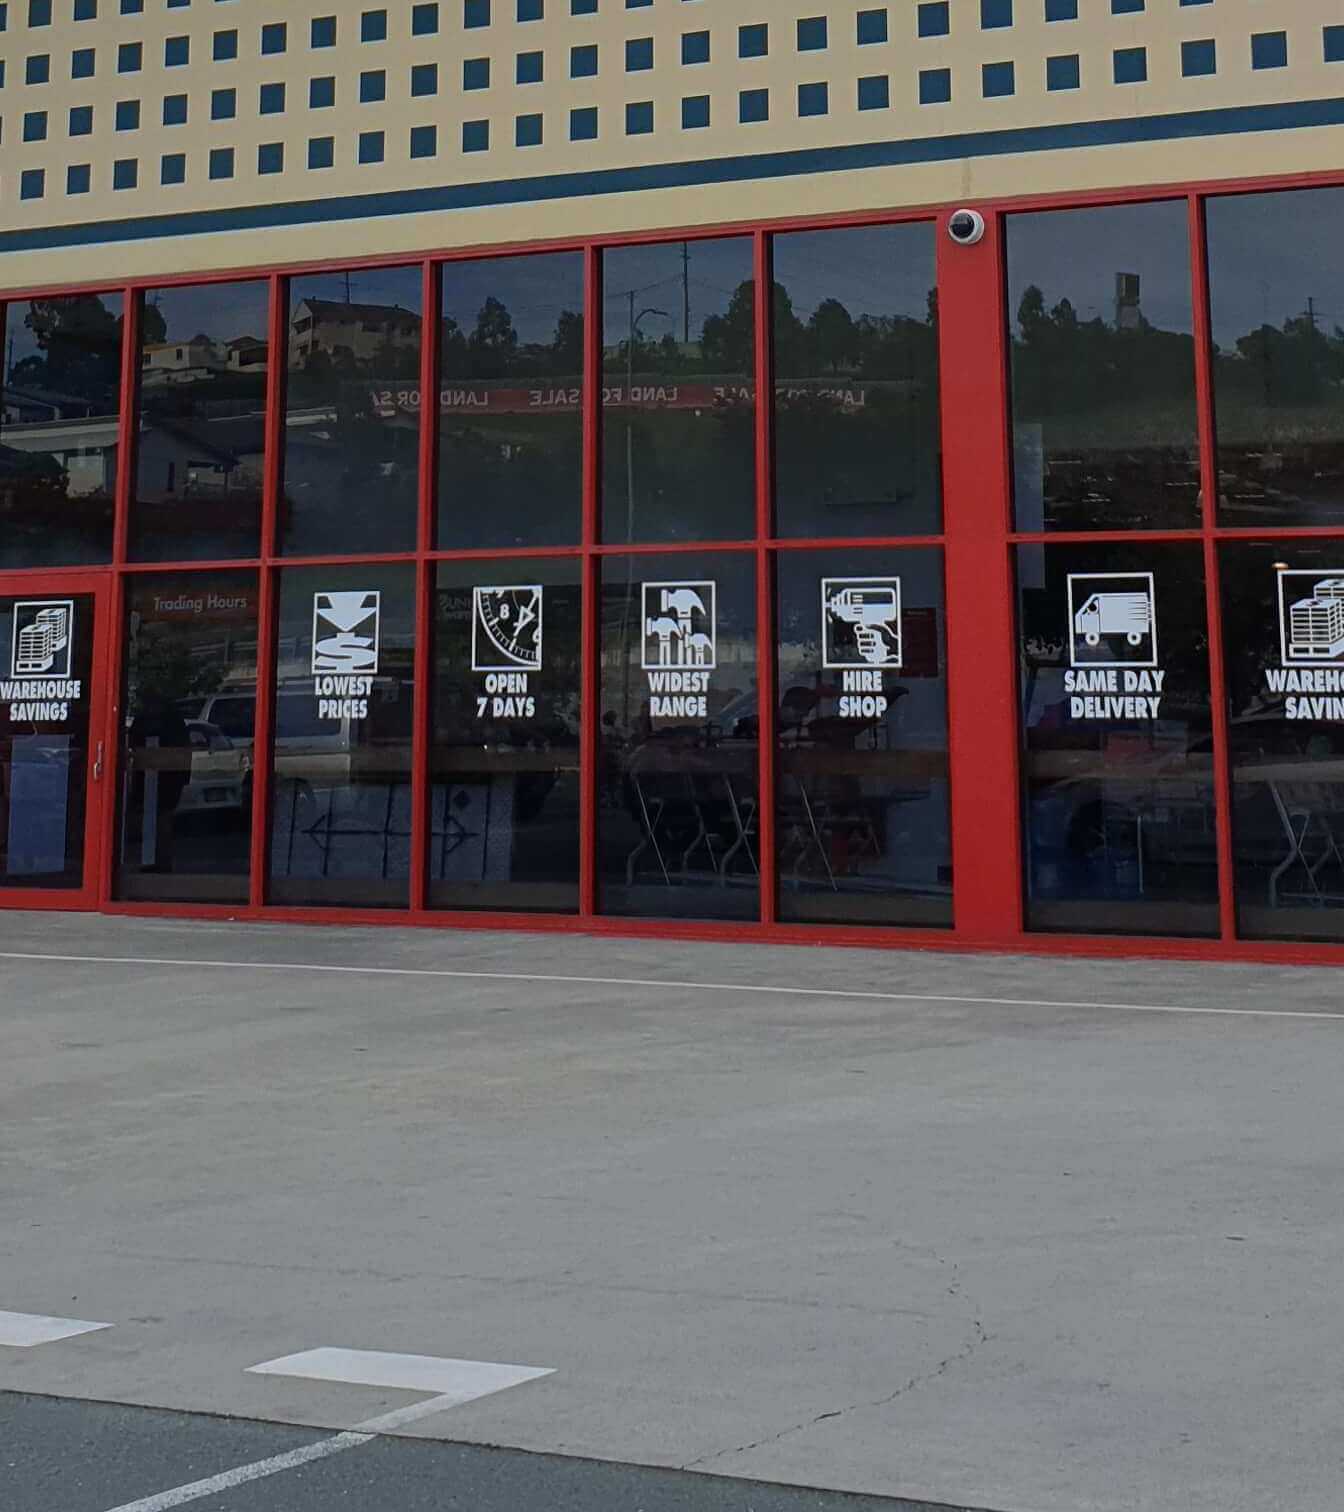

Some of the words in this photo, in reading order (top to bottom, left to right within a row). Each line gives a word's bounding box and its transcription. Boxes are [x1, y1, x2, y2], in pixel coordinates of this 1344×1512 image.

[153, 594, 203, 614] Trading
[207, 593, 248, 609] Hours
[0, 680, 81, 700] WAREHOUSE
[315, 676, 374, 696] LOWEST
[485, 673, 528, 694] OPEN
[648, 671, 710, 693] WIDEST
[842, 671, 883, 692] HIRE
[1064, 670, 1117, 692] SAME
[1124, 669, 1165, 692] DAY
[9, 702, 68, 721] SAVINGS
[318, 699, 368, 719] PRICES
[477, 696, 488, 718] 7
[493, 696, 536, 718] DAYS
[650, 696, 707, 717] RANGE
[839, 696, 888, 717] SHOP
[1070, 696, 1162, 719] DELIVERY
